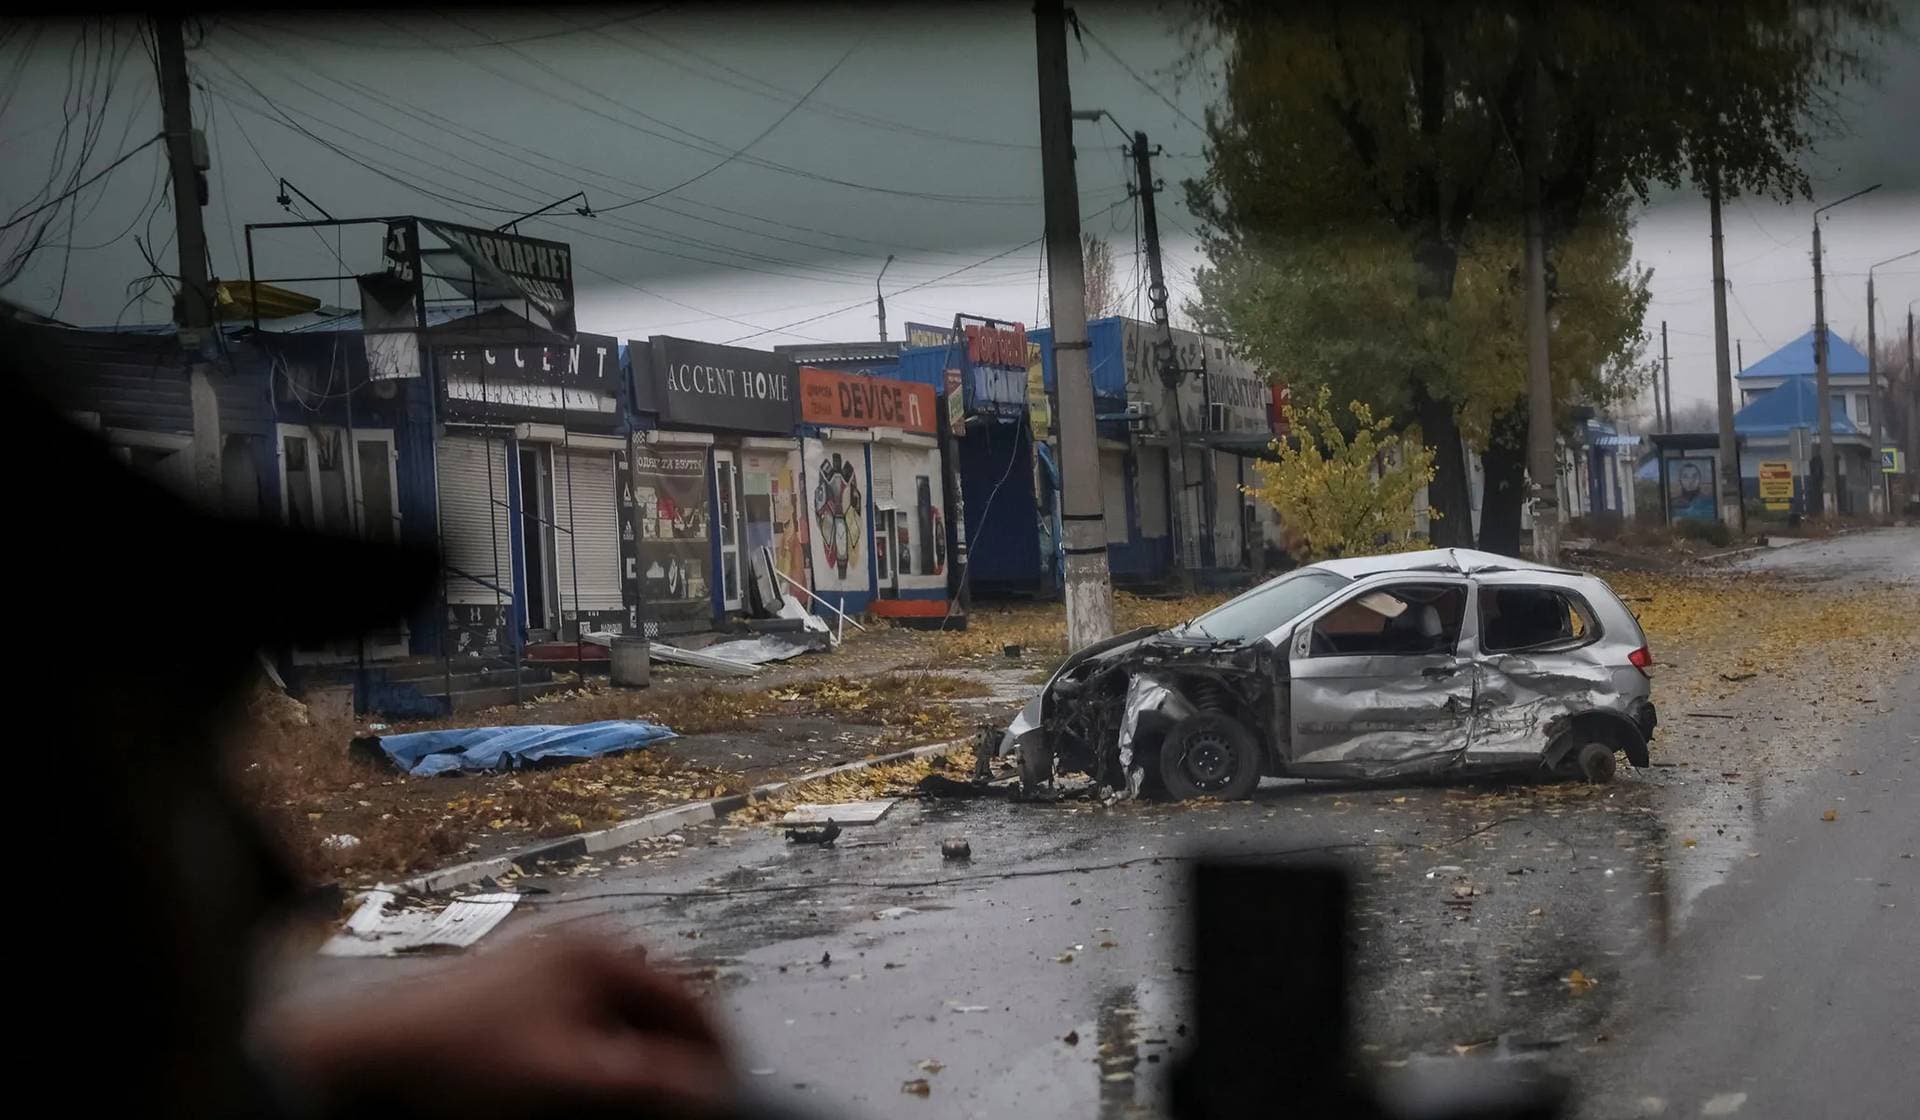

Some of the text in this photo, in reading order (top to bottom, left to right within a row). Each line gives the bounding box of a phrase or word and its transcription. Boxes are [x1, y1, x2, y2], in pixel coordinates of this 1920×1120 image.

[667, 363, 789, 402] ACCENT HOME
[838, 381, 905, 423] DEVICE
